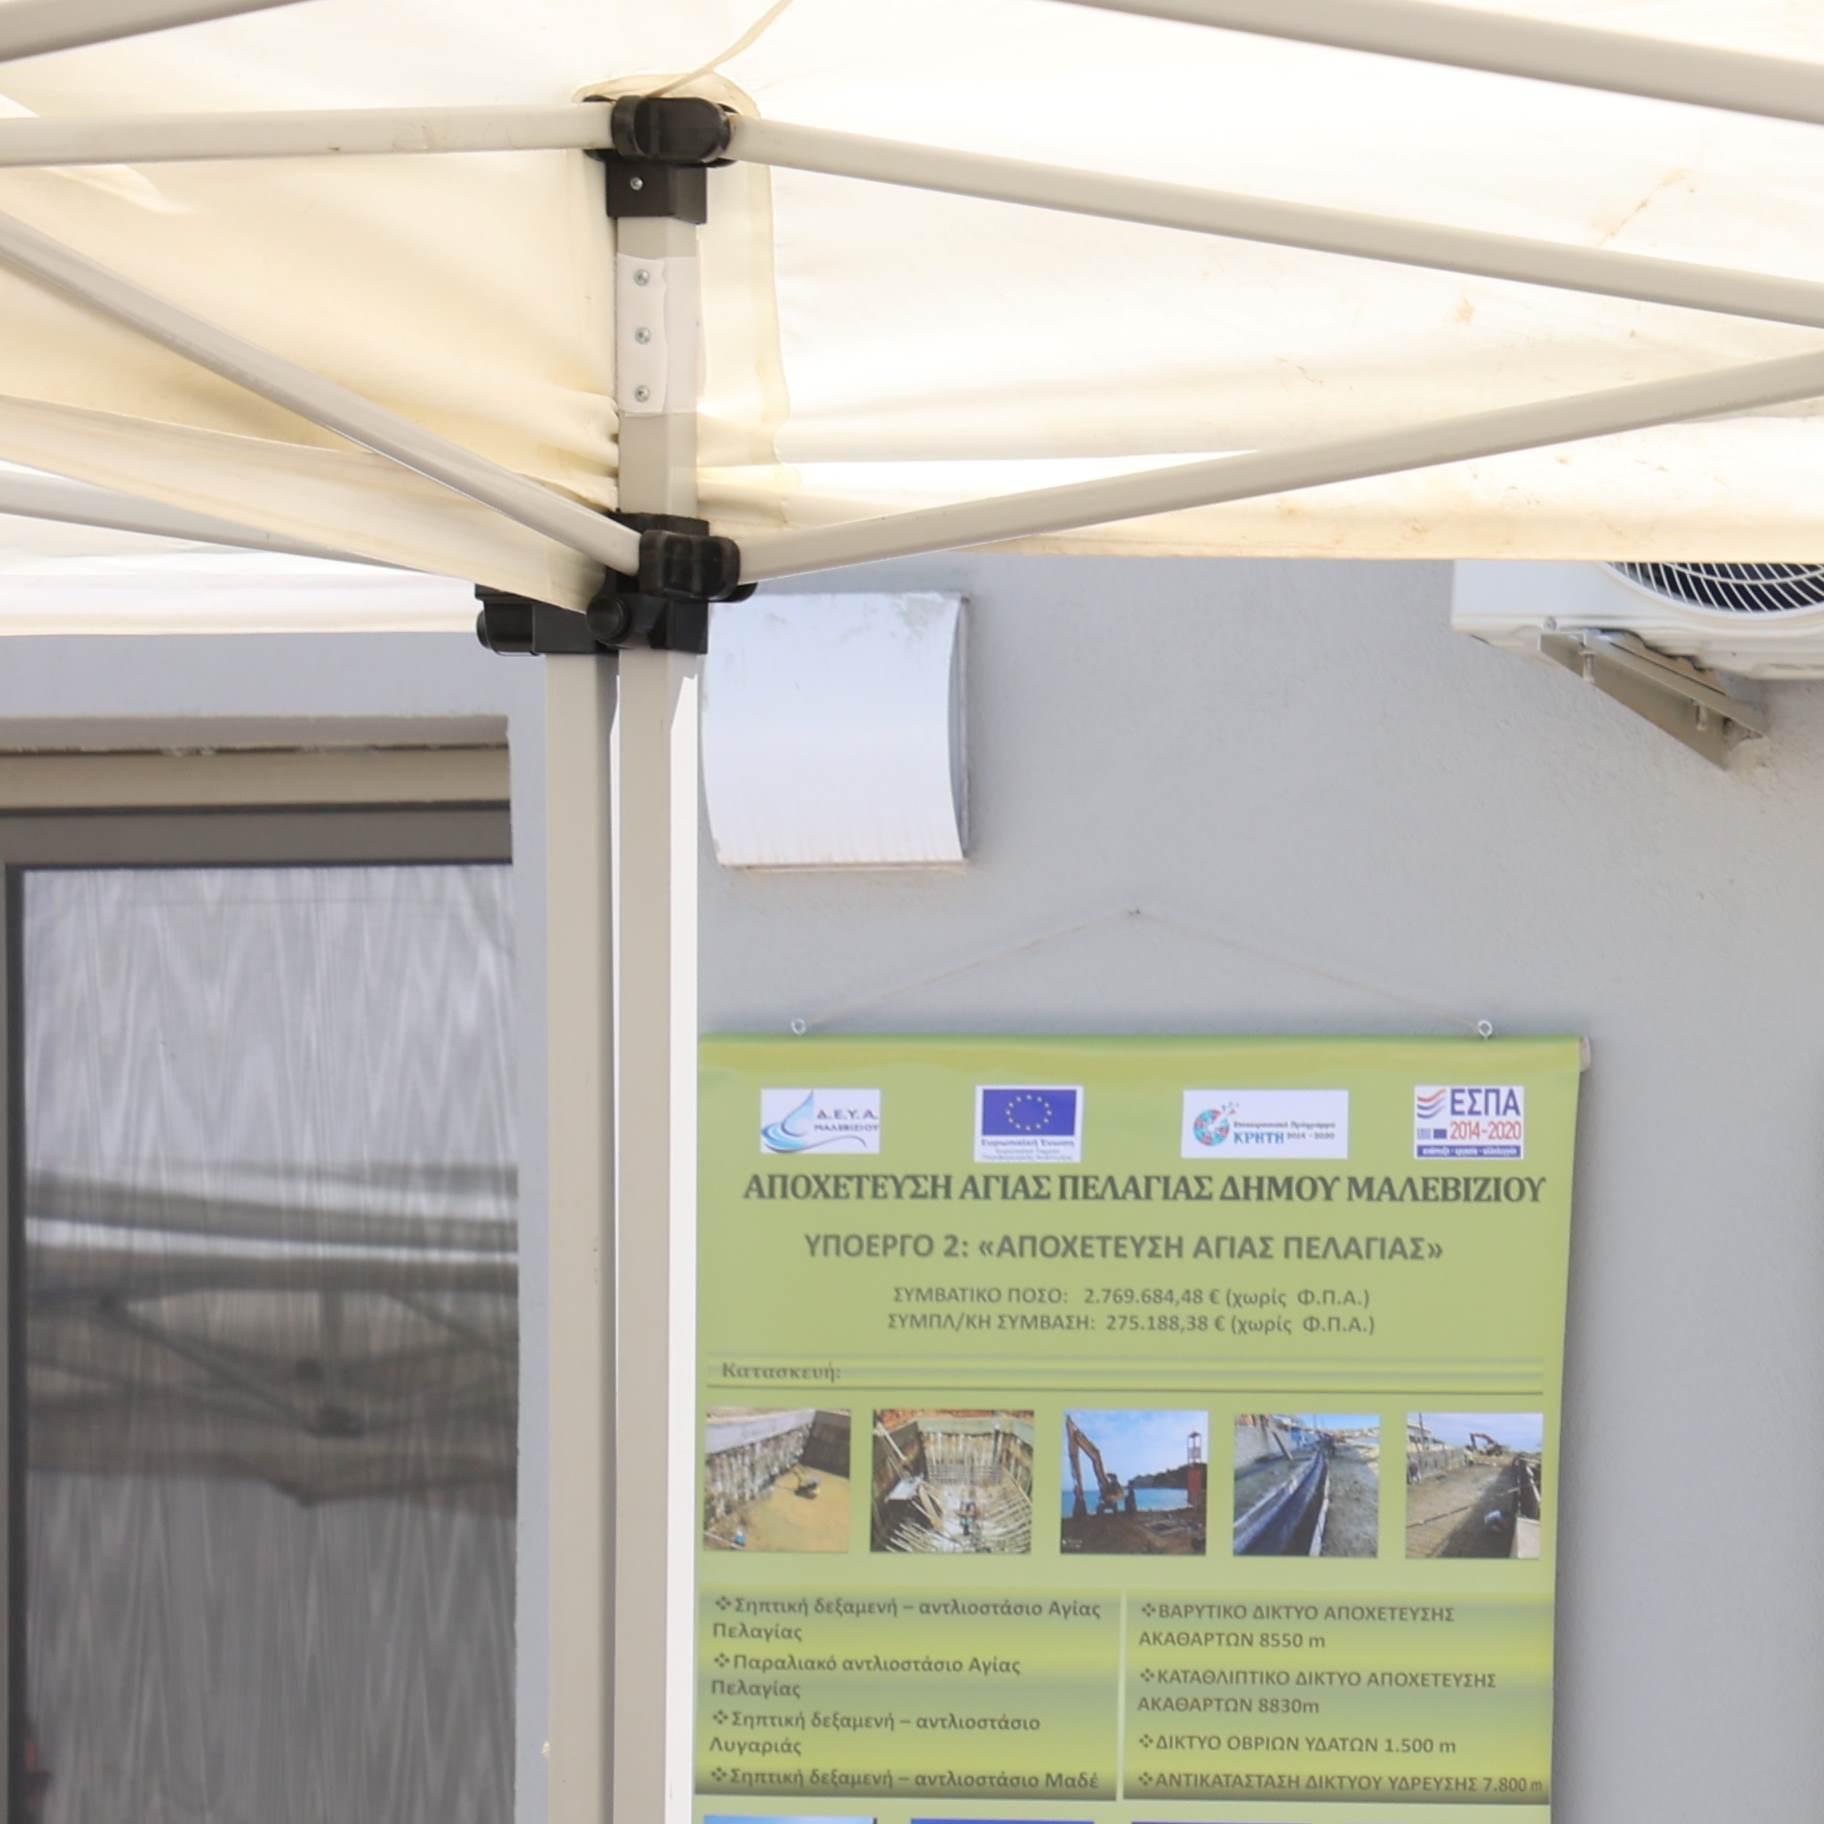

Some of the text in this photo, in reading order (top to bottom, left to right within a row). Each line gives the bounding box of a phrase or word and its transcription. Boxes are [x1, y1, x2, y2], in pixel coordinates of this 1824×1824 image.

[1450, 1088, 1521, 1116] ΕΣΠΑ
[1234, 1131, 1284, 1144] ΚΡΗΤΗ
[1450, 1121, 1521, 1141] 2014-2020
[744, 1174, 1546, 1202] ΑΠΟΧΕΤΕΥΣΗ ΑΓΙΑΣ ΠΕΛΑΓΙΑΣ ΔΗΜΟΥ ΜΑΛΕΒΙΖΙΟΥ
[804, 1234, 1442, 1260] ΥΠΟΕΡΓΟ 2: «ΑΠΟΧΕΤΕΥΣΗ ΑΓΙΑΣ ΠΕΛΑΓΙΑΣ»
[894, 1288, 1370, 1309] ΣΥΜΒΑΤΙΚΟ ΠΟΣΟ: 2.769.684,48 € (χωρίς Φ.Π.Α.)
[721, 1362, 842, 1384] Κατασκευή:
[735, 1597, 808, 1616] Σηπτική
[814, 1598, 898, 1617] δεξαμενή
[919, 1599, 1042, 1616] αντλιοστάσιο
[1048, 1600, 1100, 1620] Αγίας
[1159, 1604, 1454, 1622] ΒΑΡΥΤΙΚΟ ΔΙΚΤΥΟ ΑΠΟΧΕΤΕΥΣΗΣ
[713, 1622, 802, 1642] Πελαγίας
[1139, 1632, 1325, 1648] ΑΚΑΘΑΡΤΩΝ 8550 m
[733, 1654, 1020, 1676] Παραλιακό αντλιοστάσιο Αγίας
[712, 1679, 800, 1699] Πελαγίας
[1156, 1735, 1456, 1753] ΔΙΚΤΥΟ ΟΒΡΙΩΝ ΥΔΑΤΩΝ 1.500 m
